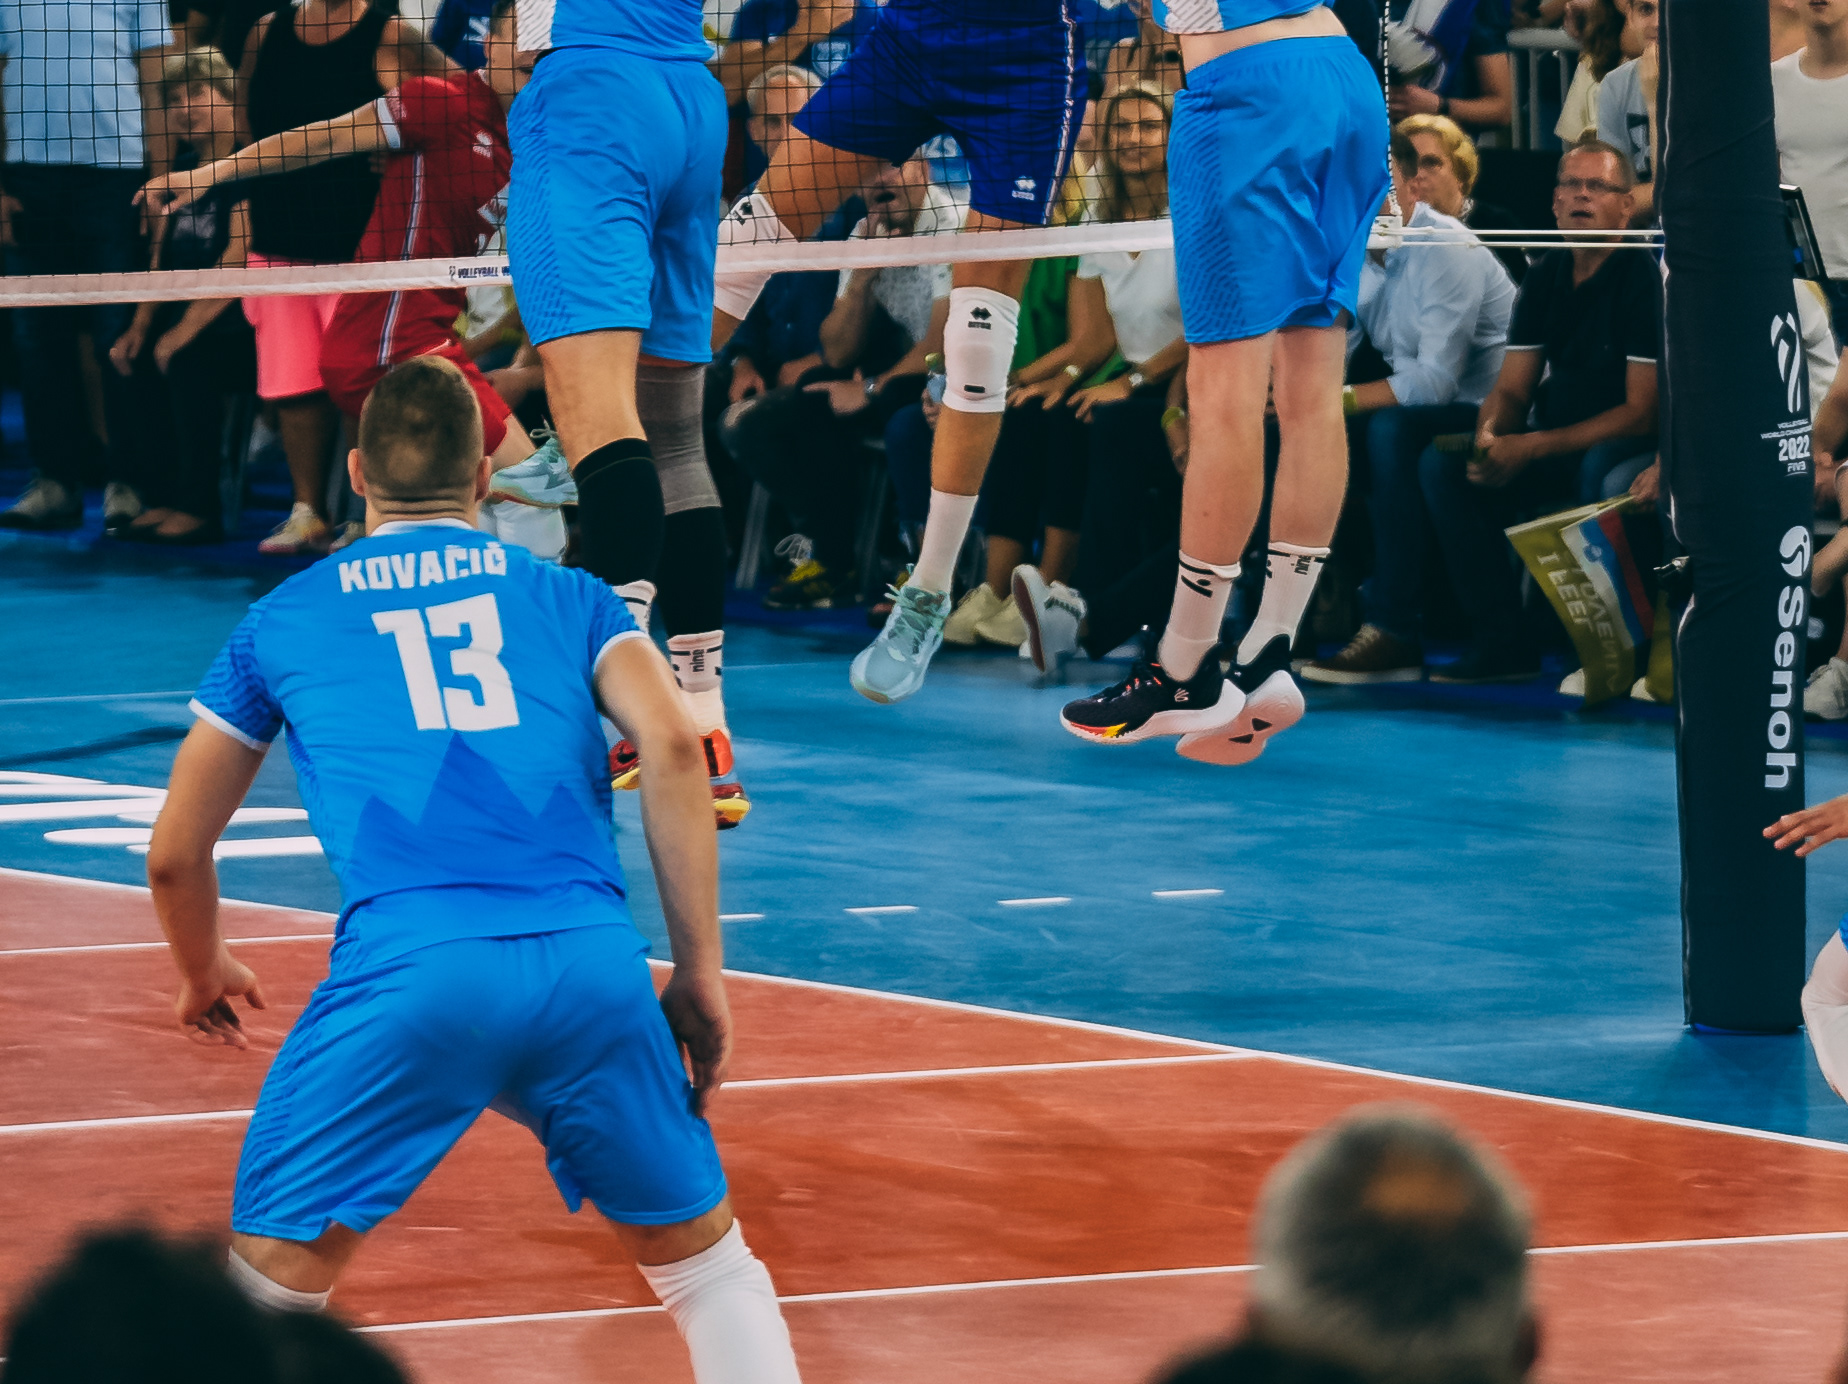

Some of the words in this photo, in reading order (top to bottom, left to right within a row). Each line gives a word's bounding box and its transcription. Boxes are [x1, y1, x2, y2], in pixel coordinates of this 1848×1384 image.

[1778, 434, 1811, 462] 2022
[1787, 460, 1806, 473] FIVB
[371, 592, 520, 733] 13
[1764, 585, 1805, 789] Senoh
